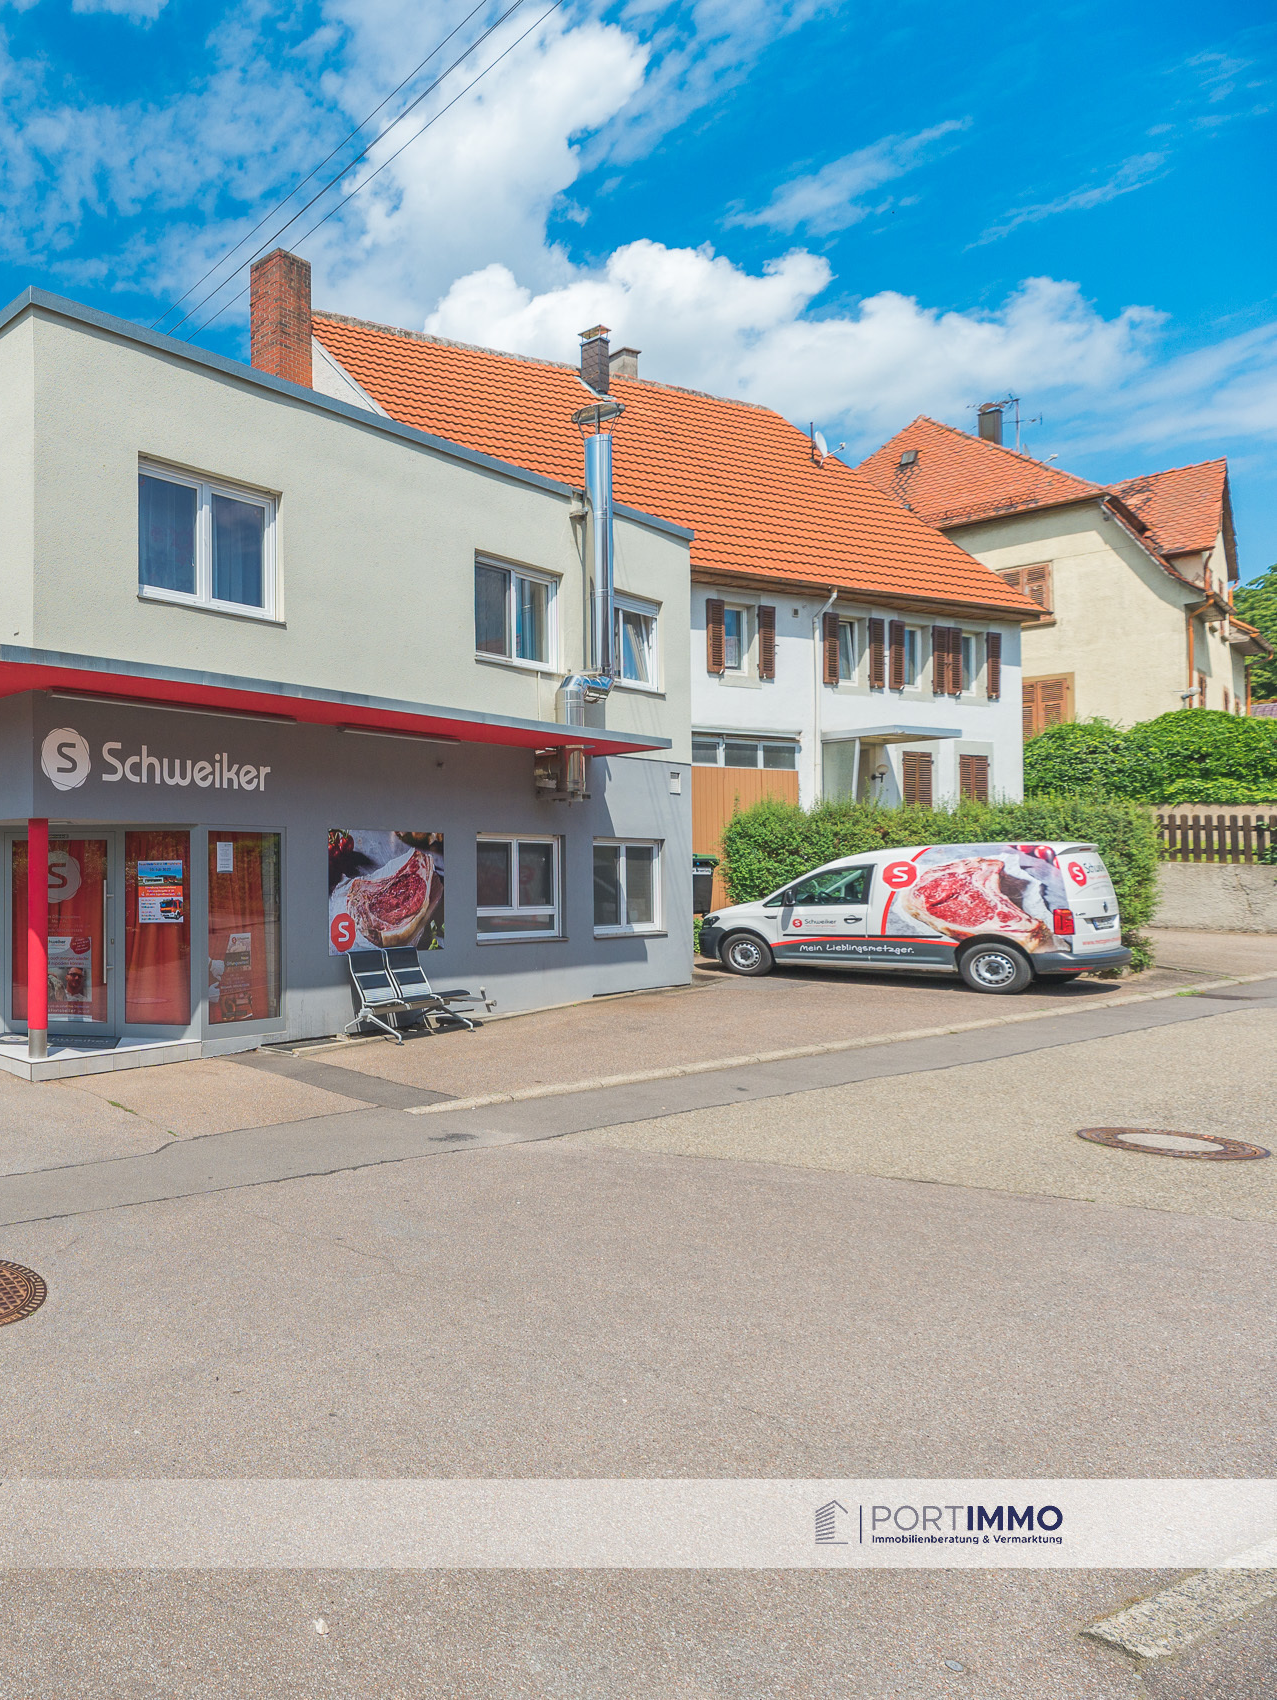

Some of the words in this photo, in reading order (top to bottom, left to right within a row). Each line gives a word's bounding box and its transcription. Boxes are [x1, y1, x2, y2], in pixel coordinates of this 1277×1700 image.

[56, 742, 79, 774] S
[101, 741, 272, 792] Schweiker
[892, 866, 909, 882] S
[338, 921, 350, 942] S
